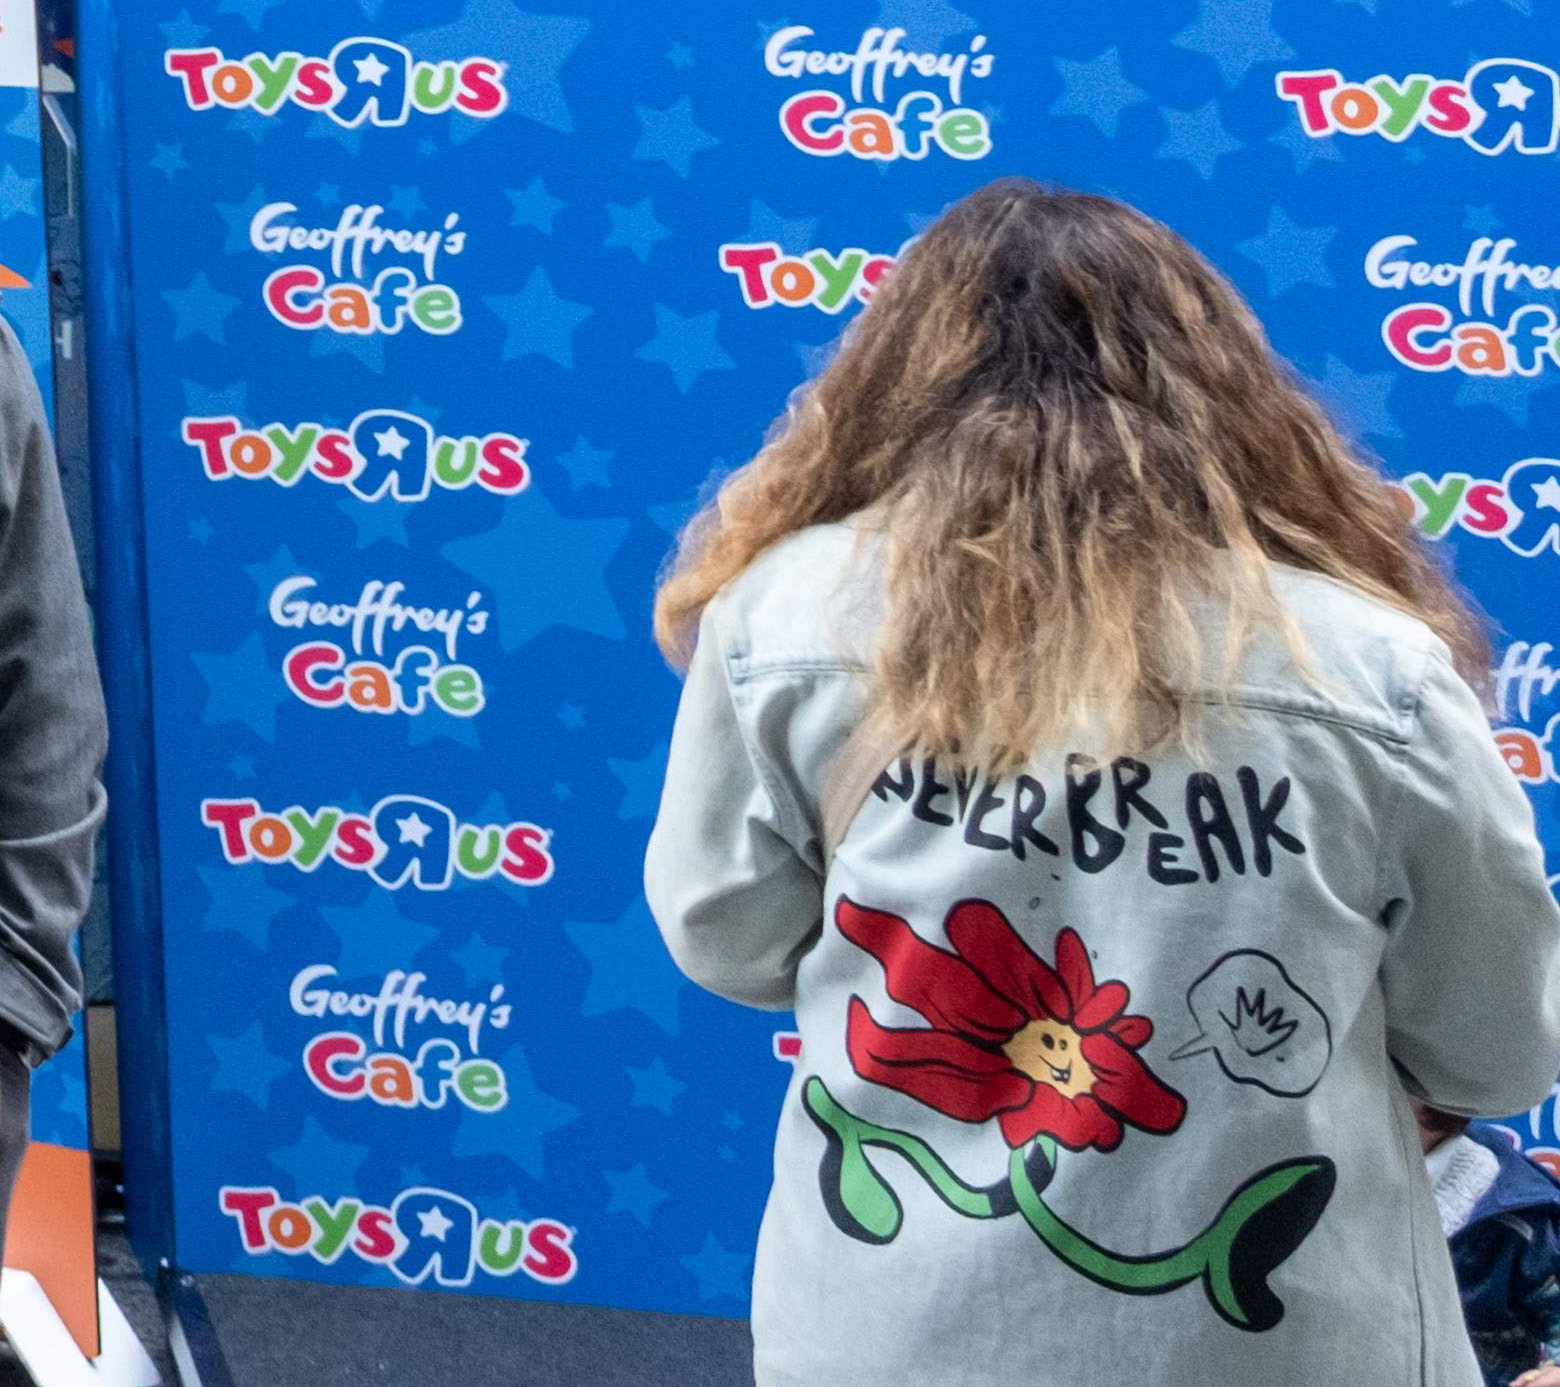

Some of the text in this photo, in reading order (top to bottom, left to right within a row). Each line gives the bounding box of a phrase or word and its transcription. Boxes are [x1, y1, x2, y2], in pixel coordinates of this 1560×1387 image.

[764, 25, 995, 104] Geoffrey's
[779, 90, 992, 161] Cafe
[249, 202, 466, 281] Geoffrey's
[1364, 234, 1560, 317] Geoffre
[262, 264, 463, 336] Cafe
[1381, 302, 1560, 377] Caf
[269, 576, 489, 660] Geoffrey's
[283, 641, 486, 717] Cafe
[289, 964, 513, 1055] Geoffrey's
[304, 1032, 509, 1112] Cafe
